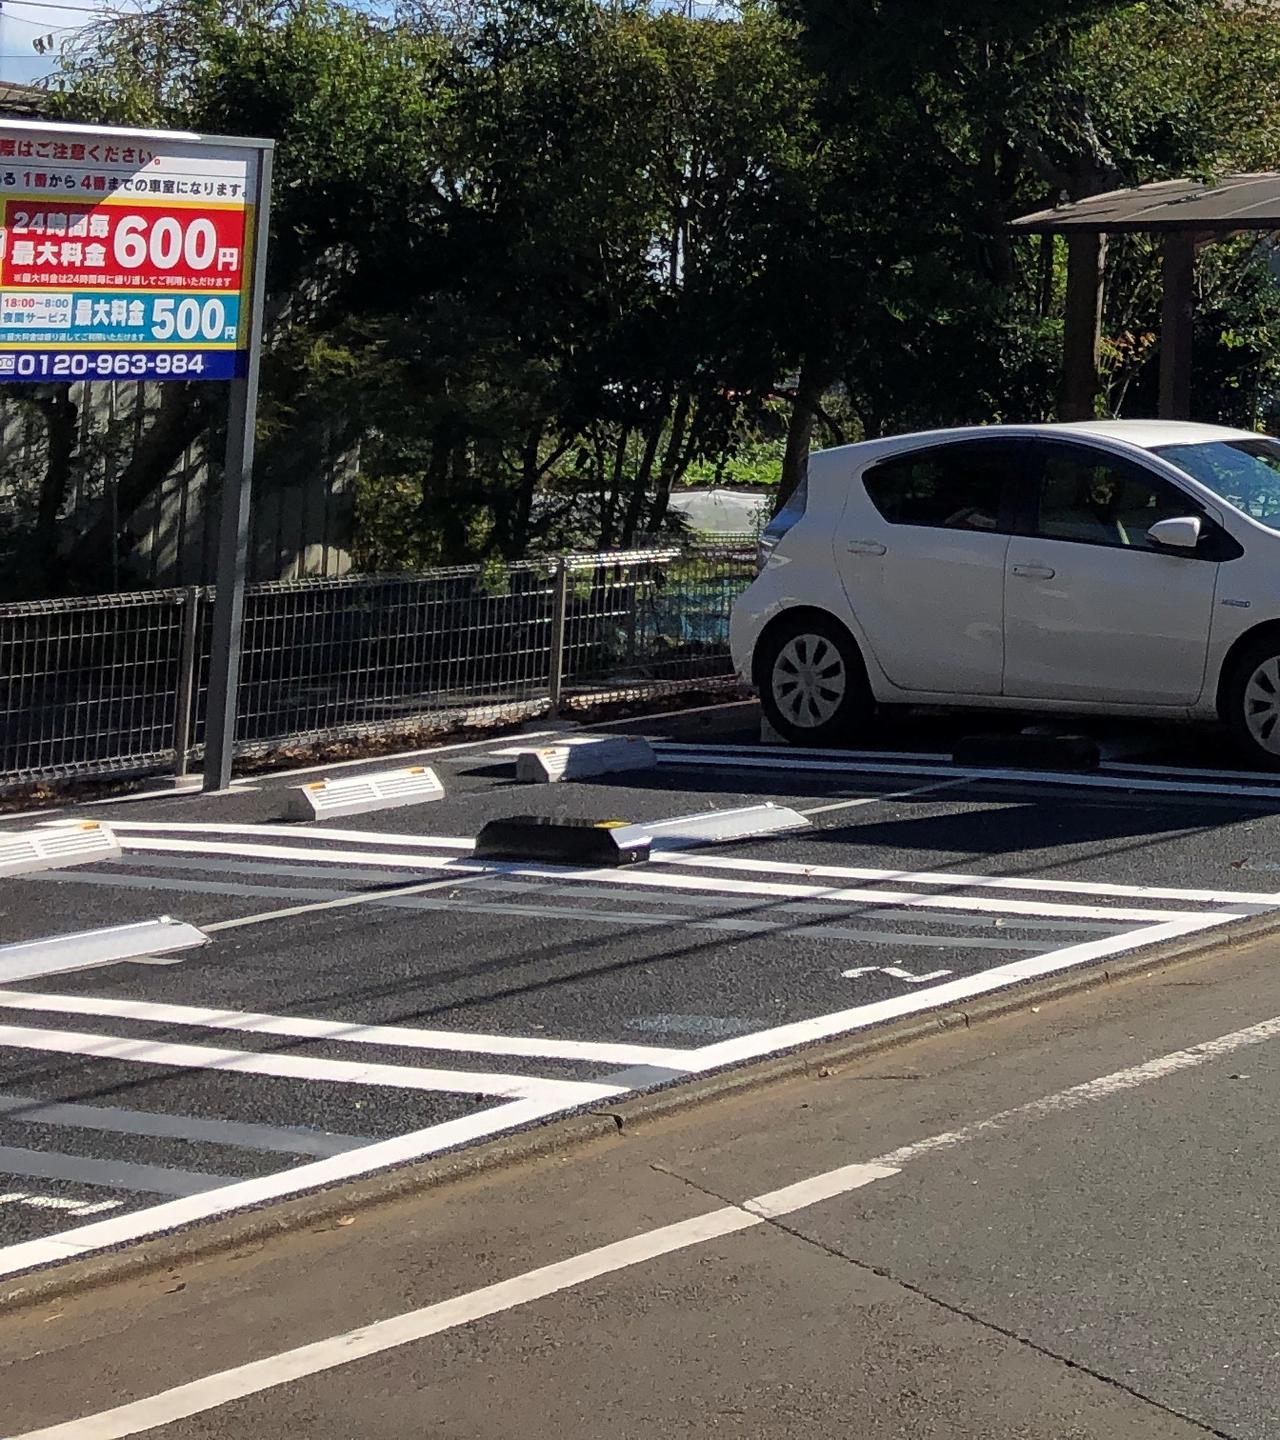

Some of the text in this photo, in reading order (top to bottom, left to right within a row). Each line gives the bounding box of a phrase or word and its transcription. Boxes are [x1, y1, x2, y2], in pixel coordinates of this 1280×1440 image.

[12, 211, 110, 239] 24時間毎
[11, 240, 107, 268] 最大料金
[113, 215, 239, 272] 600円
[3, 311, 69, 324] 夜間サービス
[75, 298, 237, 340] 最大料金 500円
[17, 354, 205, 376] 0120-963-984
